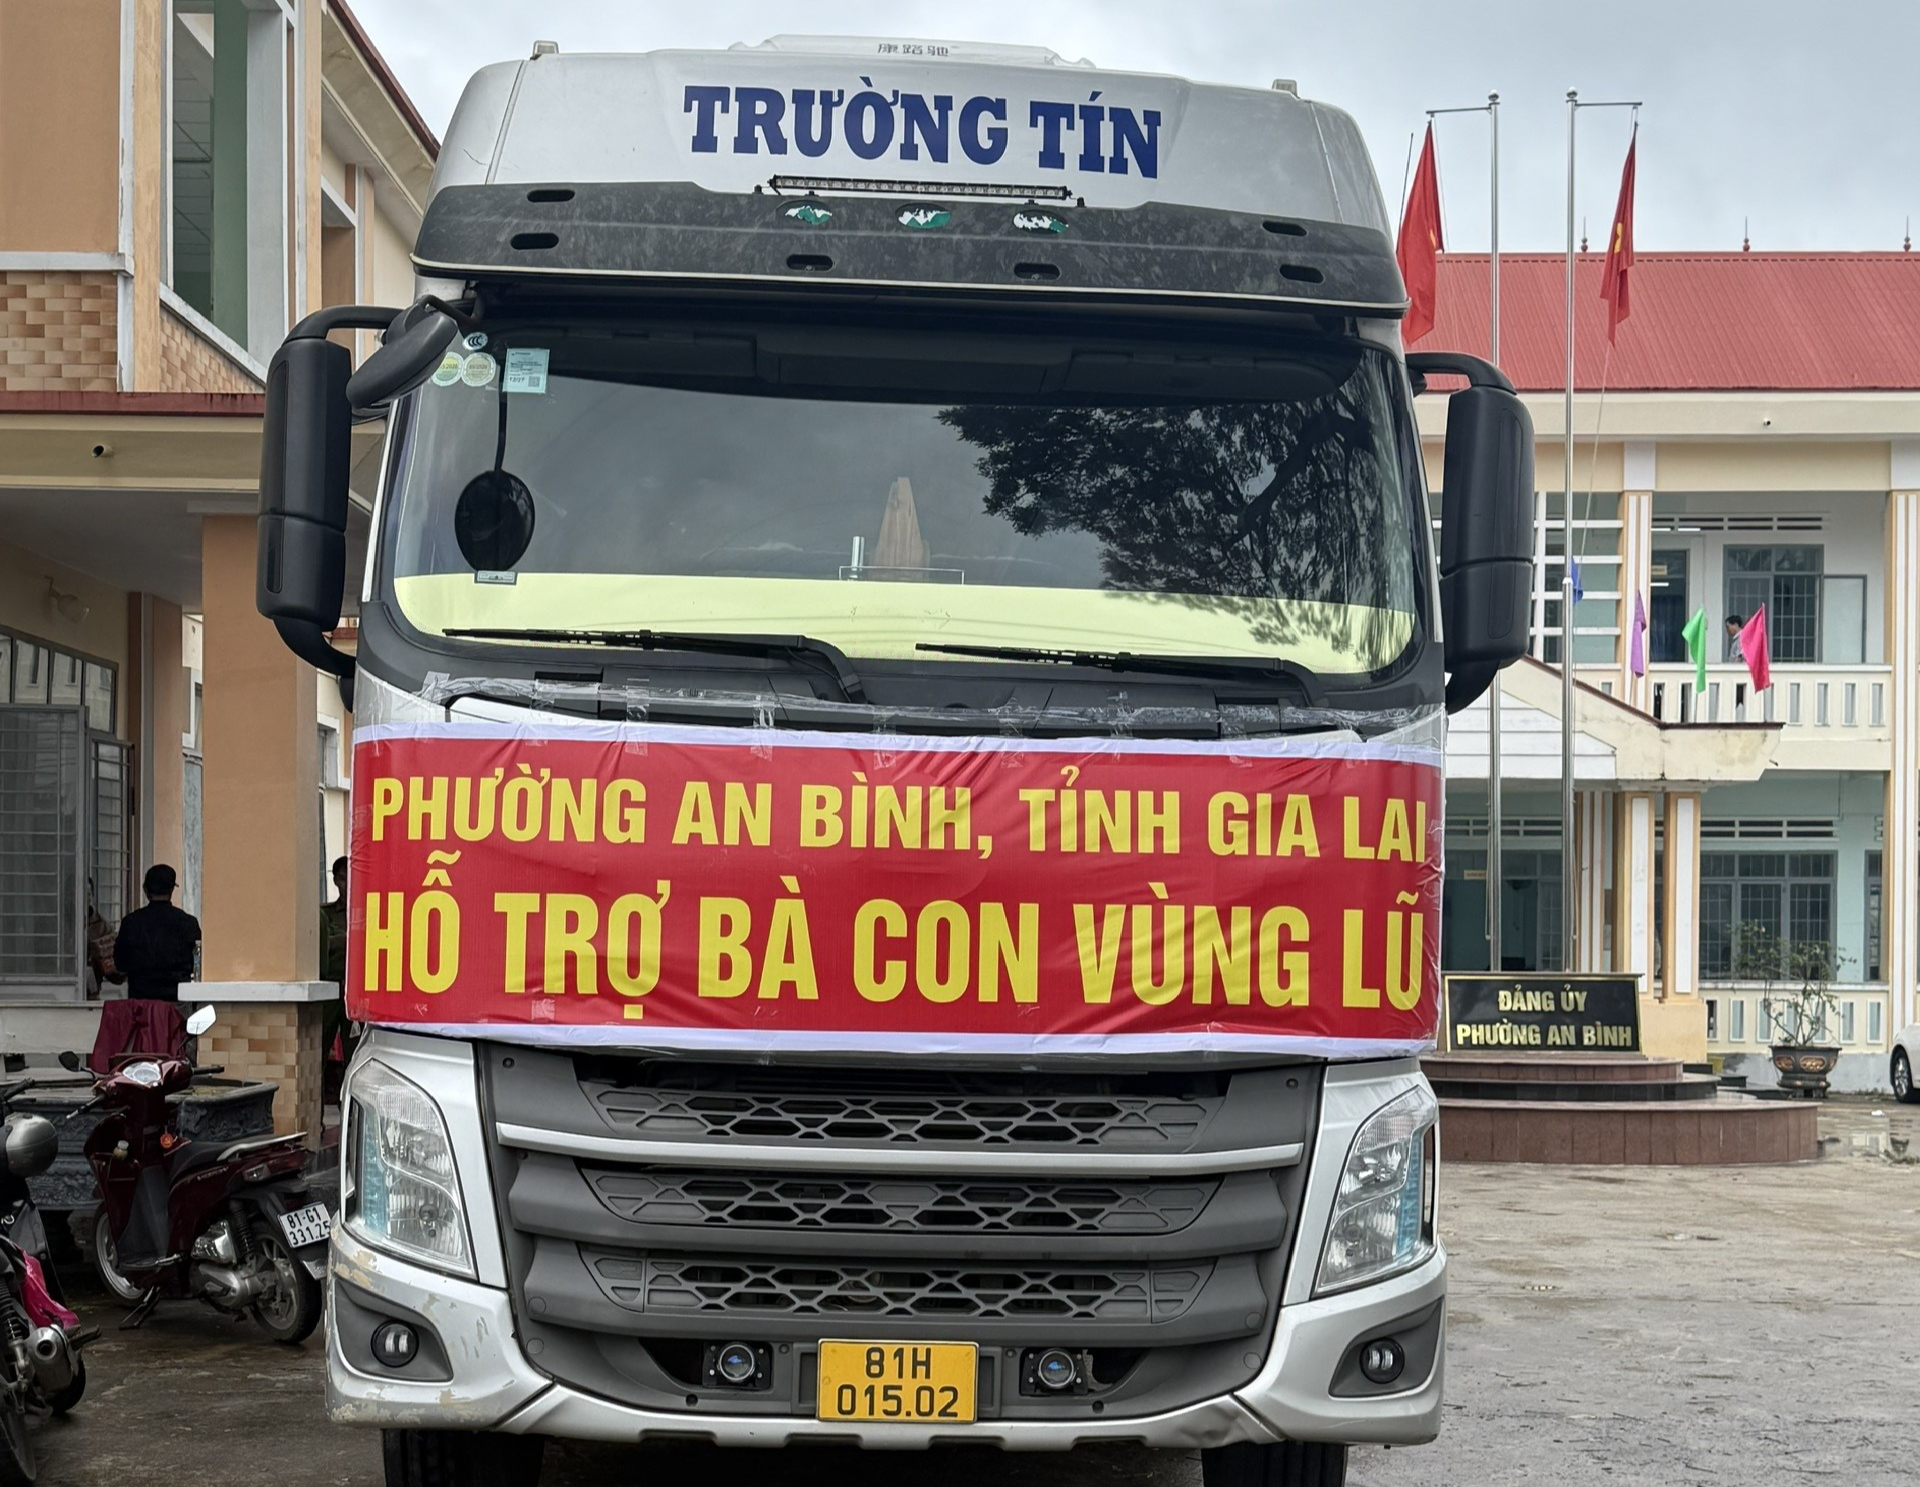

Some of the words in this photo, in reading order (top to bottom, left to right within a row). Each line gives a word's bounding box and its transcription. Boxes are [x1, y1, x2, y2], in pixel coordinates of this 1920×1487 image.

[684, 76, 1008, 165] TRƯỜNG
[1029, 90, 1161, 179] TÍN
[372, 763, 646, 844] PHƯỜNG
[671, 781, 772, 847] AN
[800, 771, 993, 859] BÌNH,
[1019, 766, 1181, 855] TỈNH
[1207, 791, 1320, 858] GIA
[1343, 796, 1426, 863] LAI
[364, 849, 461, 994] HỖ
[494, 879, 671, 1020] TRỢ
[698, 875, 819, 1000] BÀ
[853, 898, 1039, 1003] CON
[1073, 882, 1310, 1008] VÙNG
[1342, 891, 1424, 1011] LŨ
[1498, 984, 1555, 1012] ĐẢNG
[1561, 984, 1588, 1012] ỦY
[1456, 1018, 1541, 1046] PHƯỜNG
[1547, 1025, 1576, 1046] AN
[1582, 1021, 1632, 1047] BÌNH
[865, 1347, 931, 1379] 81H
[837, 1384, 959, 1417] 015.02
